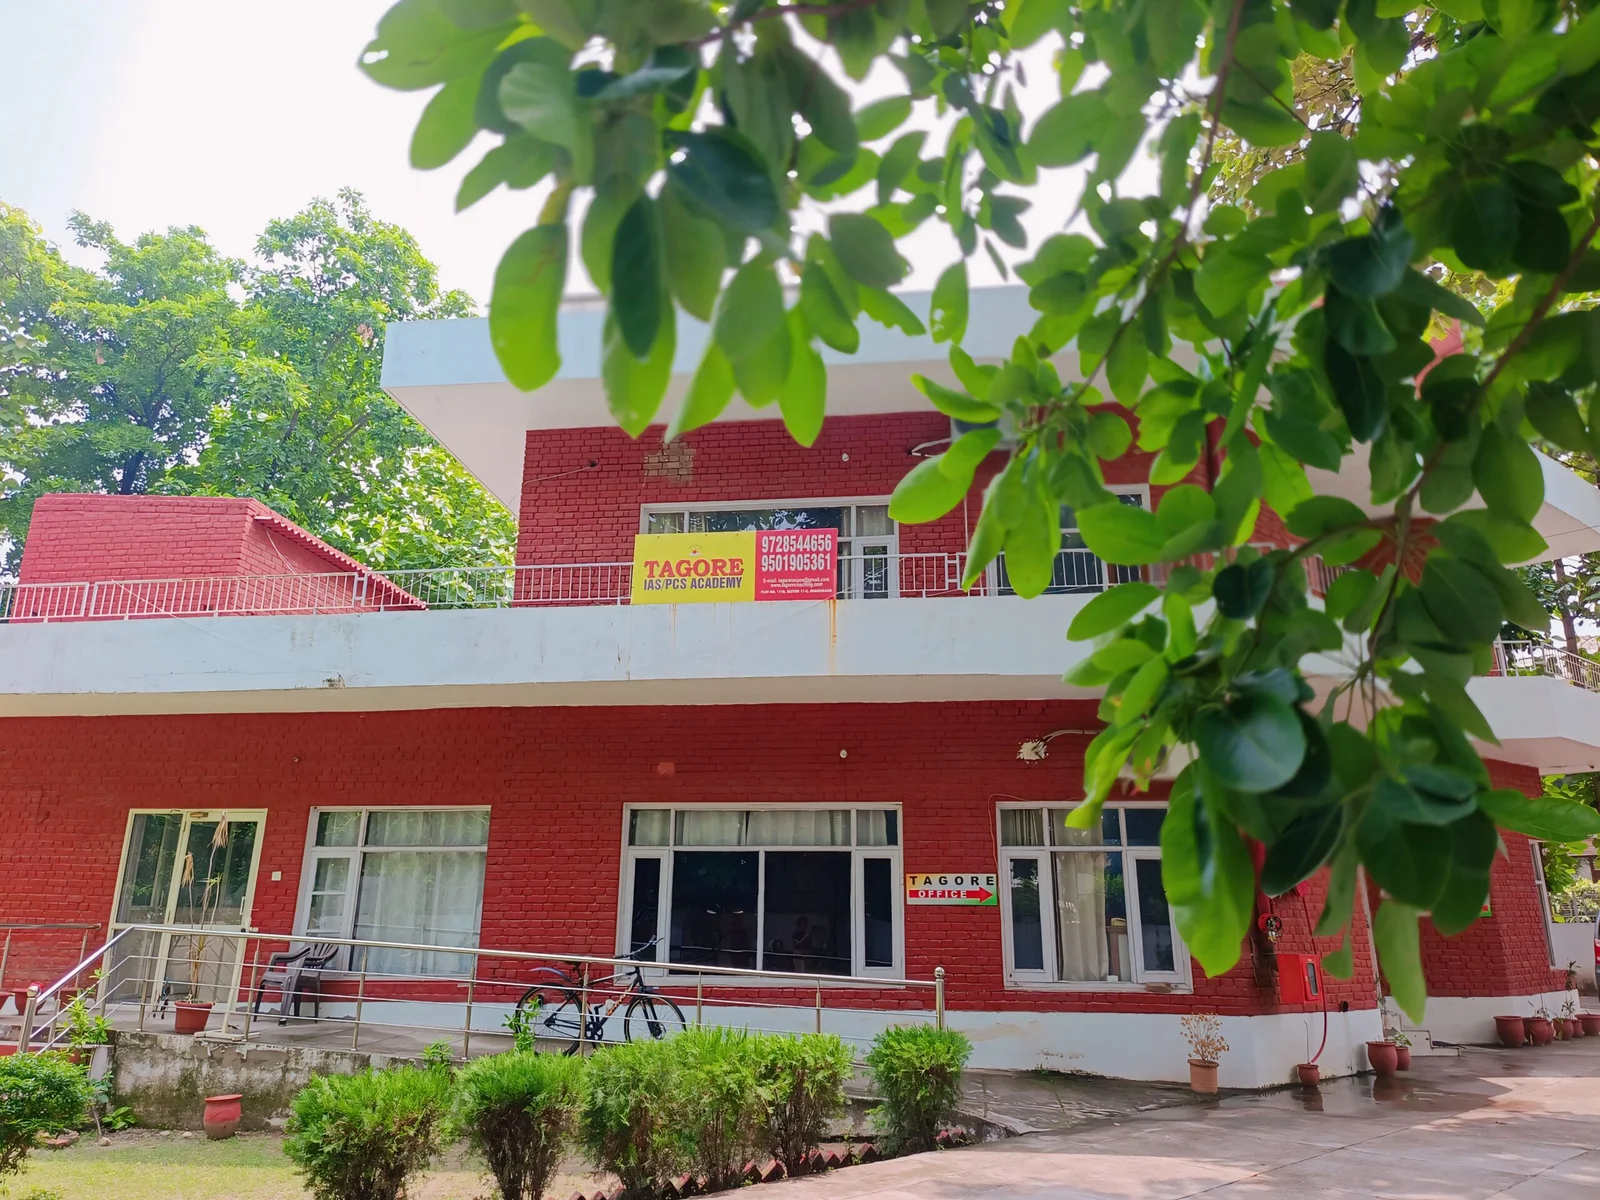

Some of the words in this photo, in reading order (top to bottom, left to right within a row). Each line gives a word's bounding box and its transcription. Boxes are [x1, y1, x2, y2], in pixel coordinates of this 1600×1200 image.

[761, 534, 832, 553] 9728544656
[643, 558, 744, 578] TAGORE
[761, 553, 831, 572] 9501905361
[643, 578, 687, 591] IAS/PCS
[690, 576, 743, 589] ACADEMY
[909, 875, 995, 886] TAGORE
[918, 890, 967, 898] OFFICE
